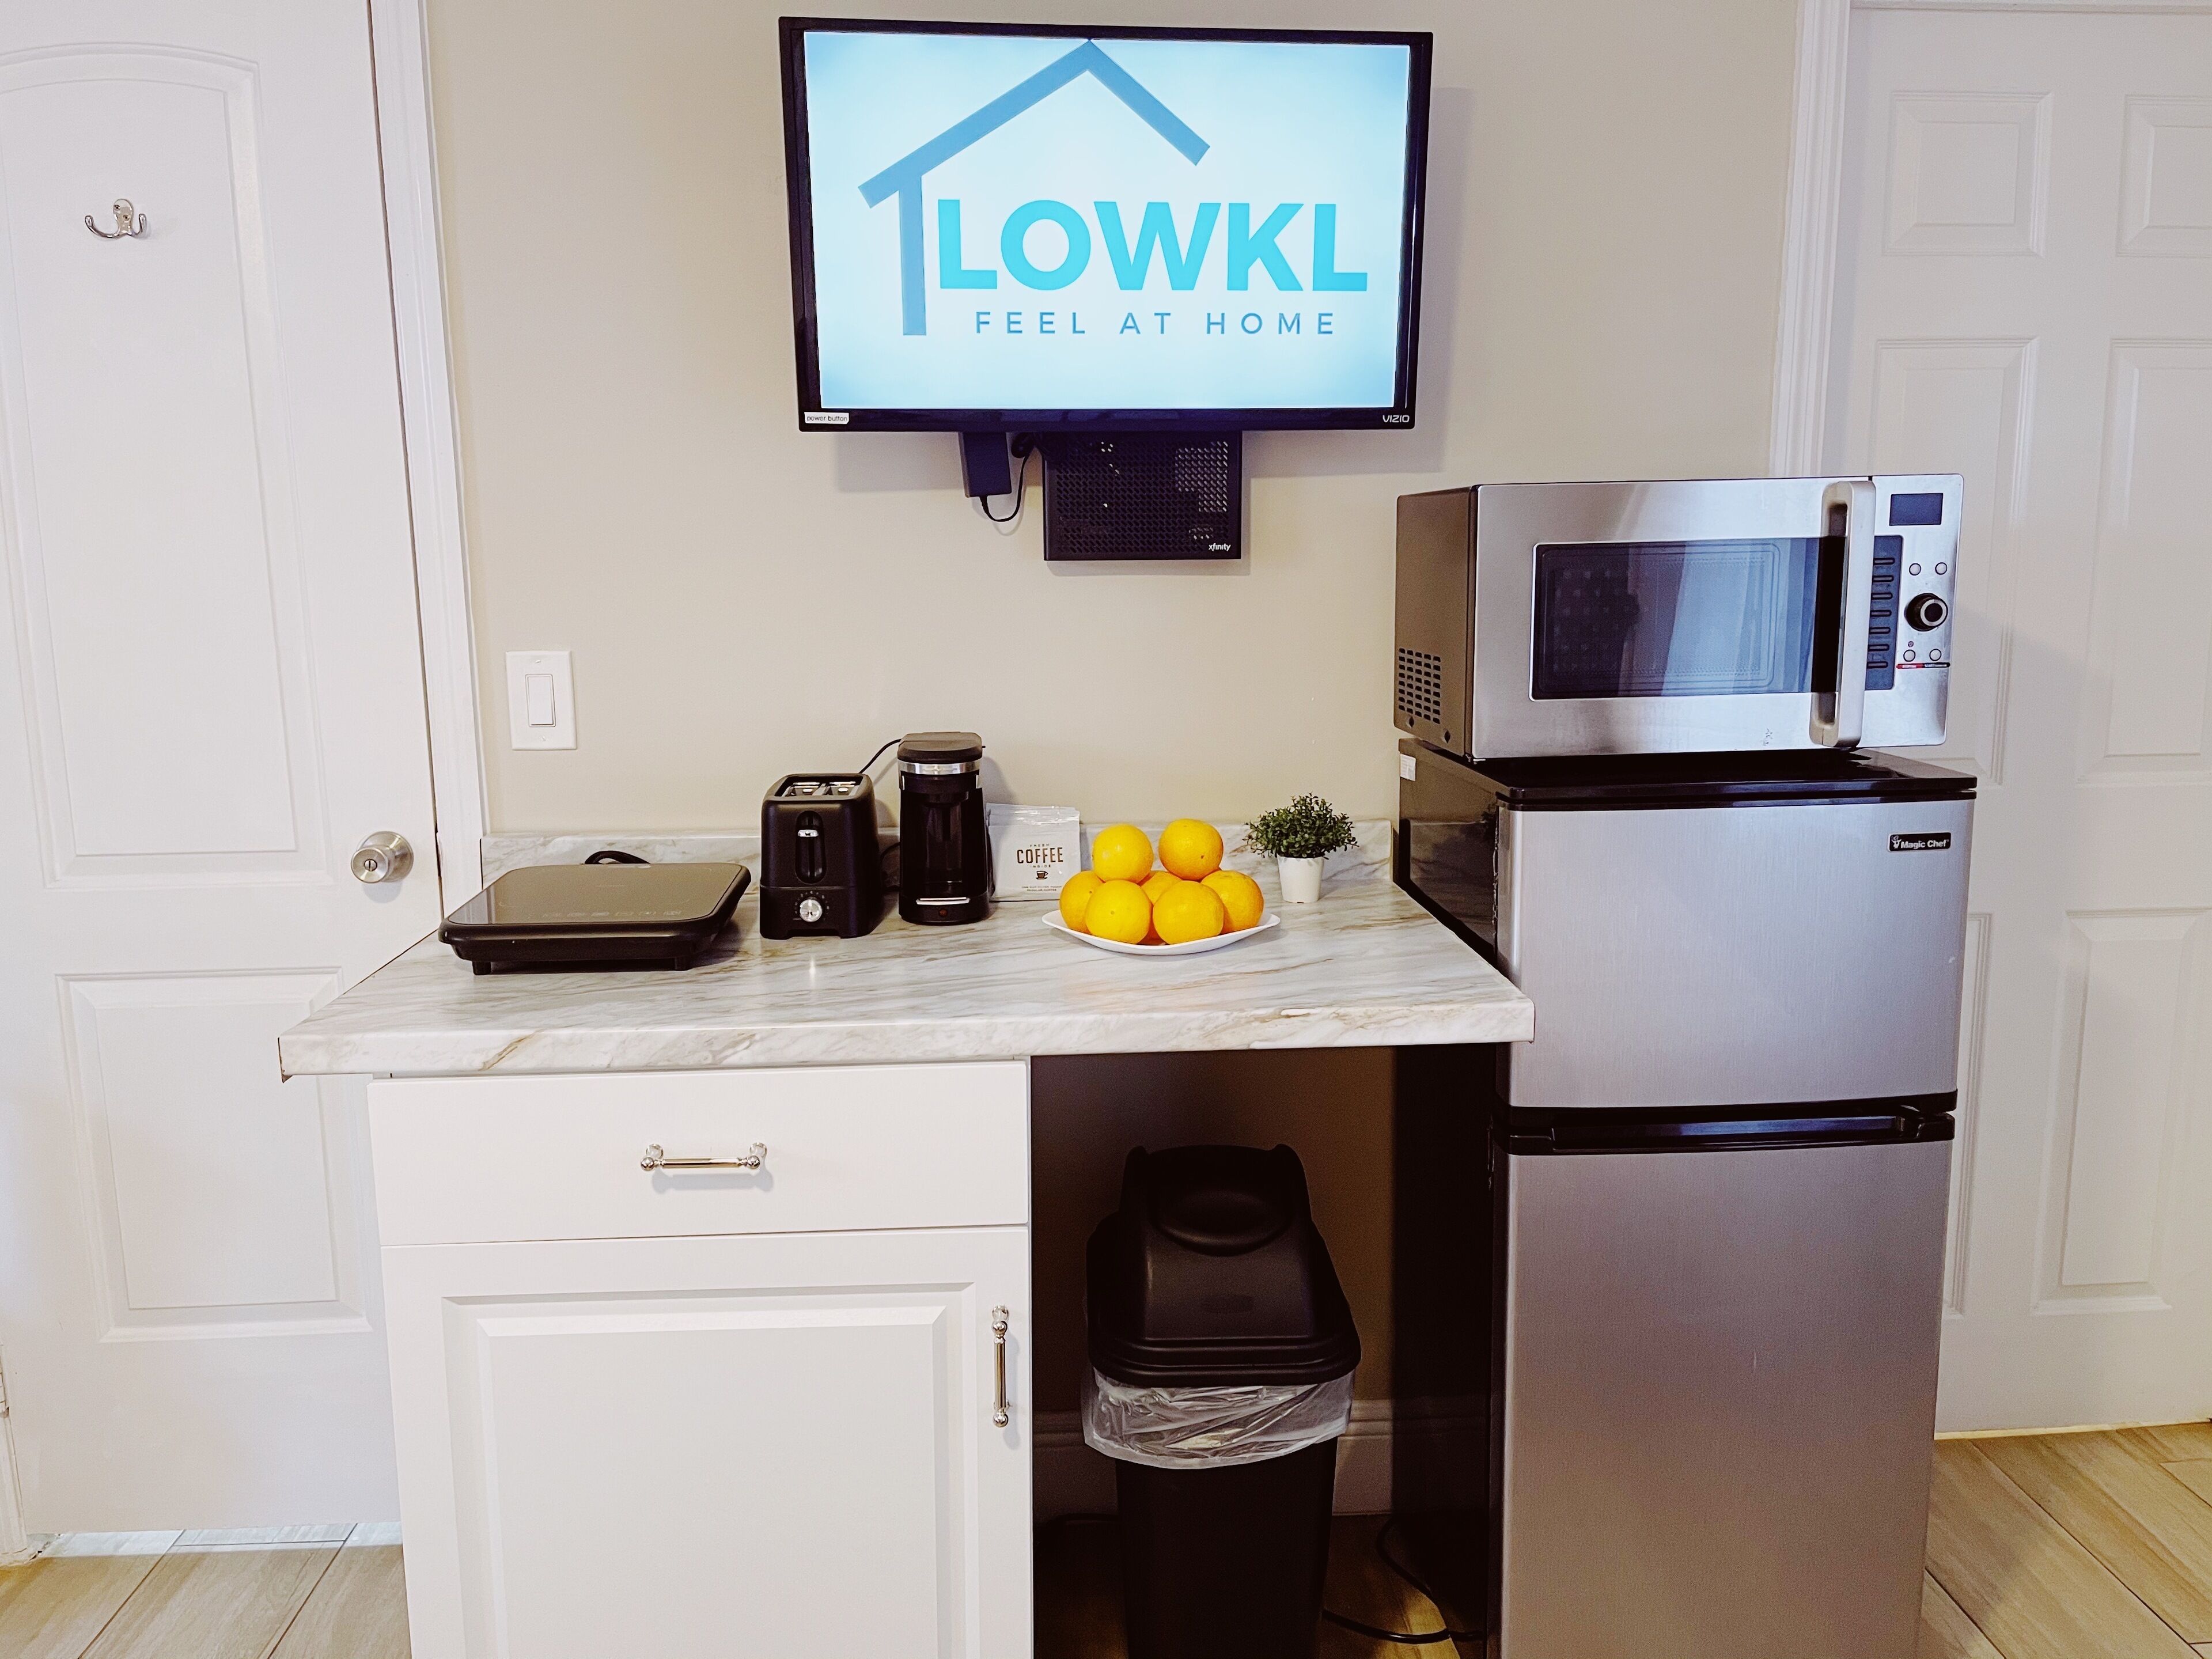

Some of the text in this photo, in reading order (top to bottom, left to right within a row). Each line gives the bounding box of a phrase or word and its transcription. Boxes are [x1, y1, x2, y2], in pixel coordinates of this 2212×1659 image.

[937, 199, 1368, 291] LOWKL
[976, 311, 1334, 335] FEEL AT HOME
[1382, 414, 1410, 423] VIZIO
[1208, 543, 1231, 552] xfinity
[1900, 839, 1946, 850] Magic Chef
[1017, 847, 1064, 864] COFFEE
